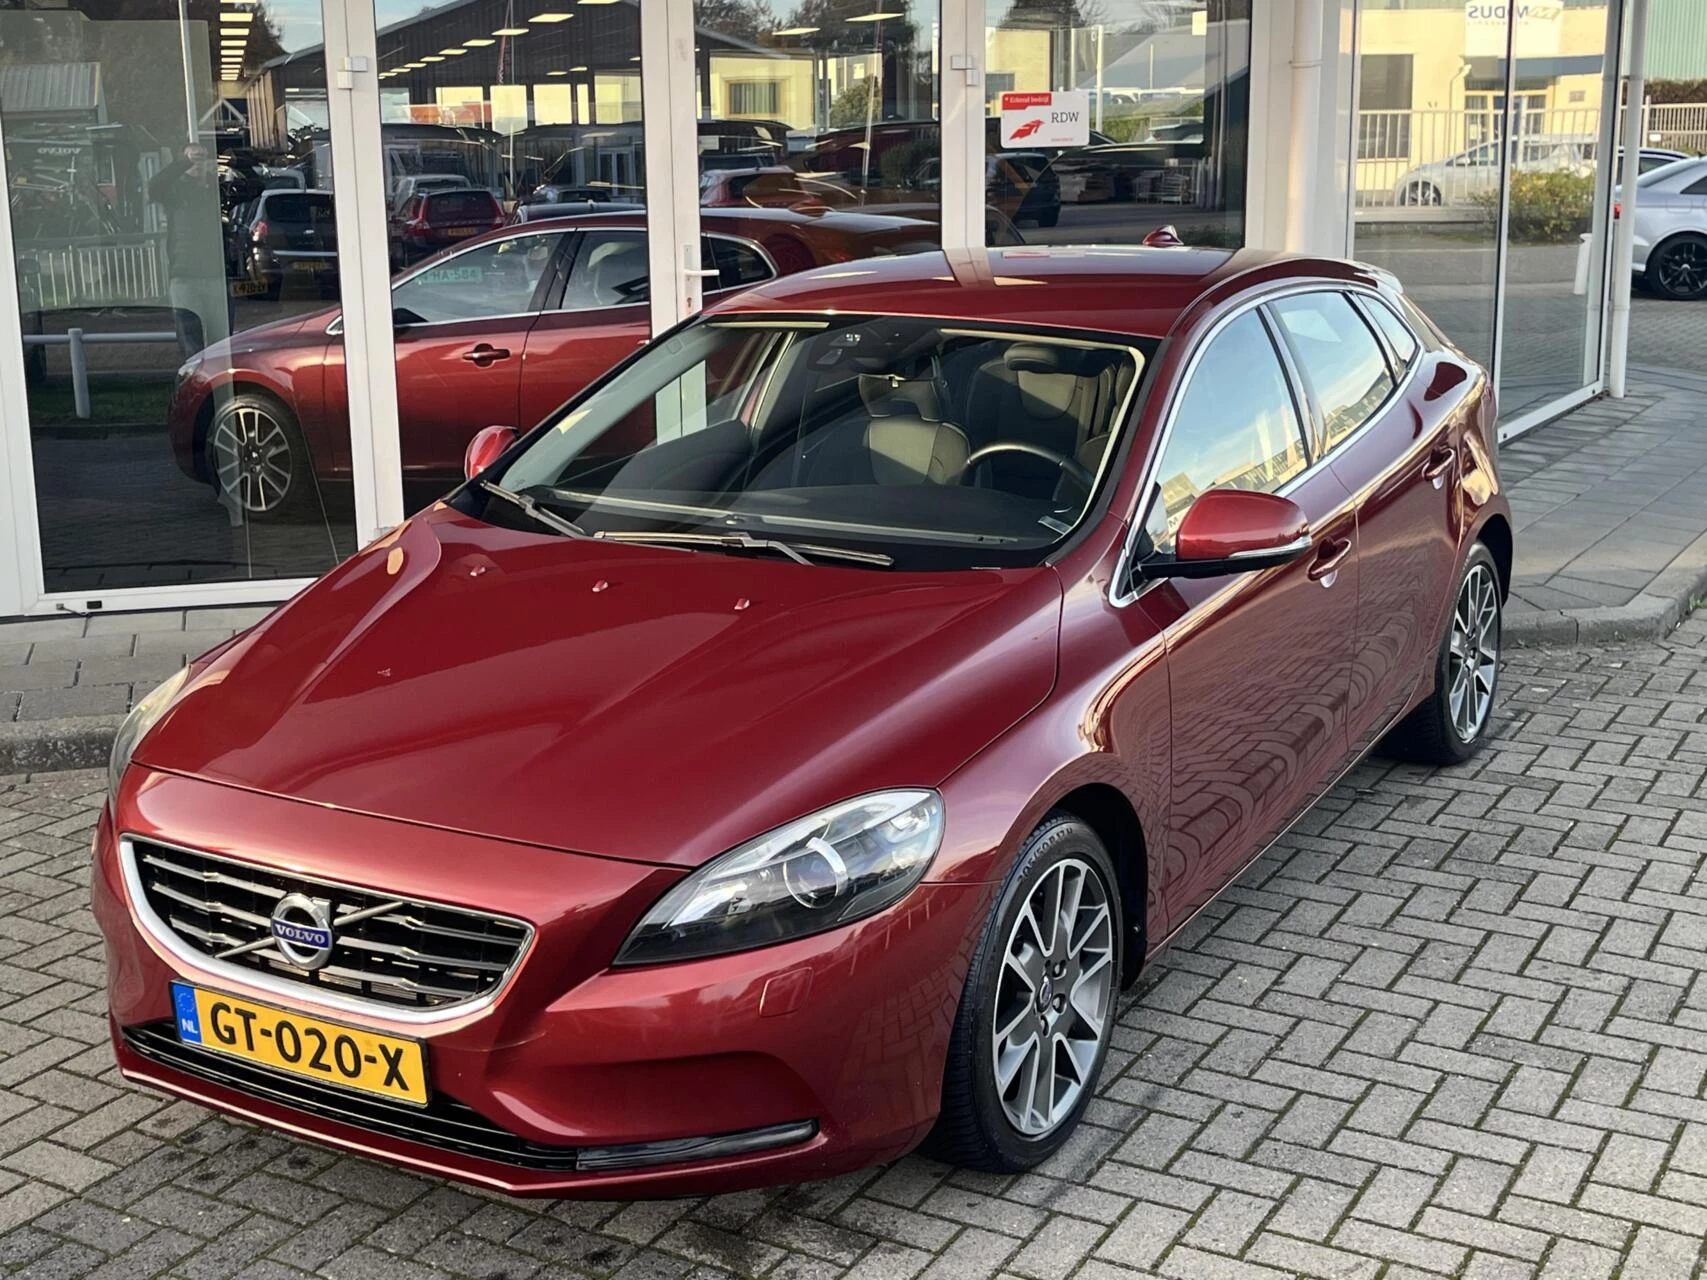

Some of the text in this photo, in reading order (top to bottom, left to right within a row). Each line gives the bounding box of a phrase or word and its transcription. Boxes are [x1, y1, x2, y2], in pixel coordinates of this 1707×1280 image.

[1051, 112, 1080, 123] RDW
[274, 924, 326, 944] VOLVO
[181, 1018, 198, 1034] NL
[210, 1002, 409, 1091] GT-020-X
